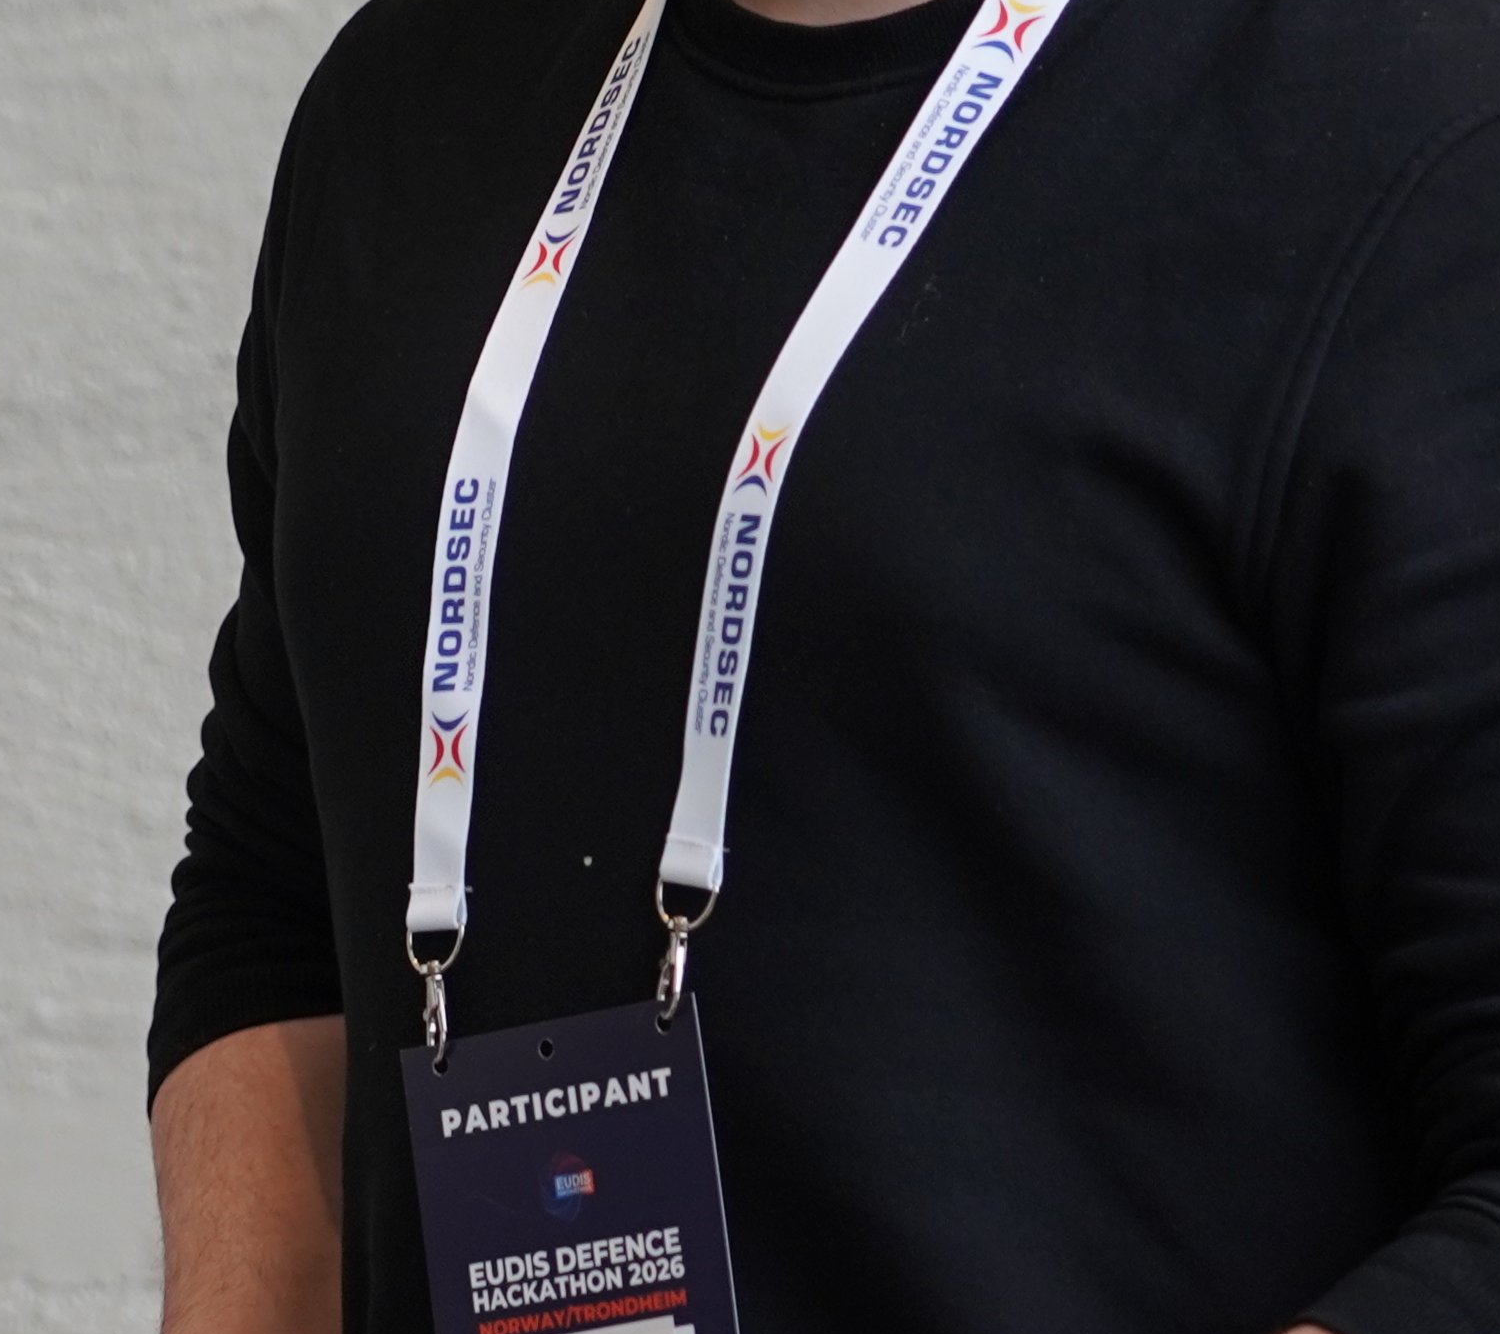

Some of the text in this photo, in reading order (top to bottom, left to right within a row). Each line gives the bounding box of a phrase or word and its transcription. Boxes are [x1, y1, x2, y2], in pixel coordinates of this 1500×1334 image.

[946, 64, 971, 97] Nordic
[553, 37, 641, 214] NORDSEC
[920, 98, 950, 139] Defence
[878, 72, 1002, 247] NORDSEC
[906, 141, 922, 160] and
[880, 162, 912, 203] Security
[719, 512, 735, 553] Nordic
[432, 478, 479, 692] NORDSEC
[462, 477, 496, 691] Nordic Defence and Security Cluster
[710, 556, 726, 606] Defence
[706, 609, 716, 632] and
[710, 514, 761, 736] NORDSEC
[699, 634, 715, 685] Security
[440, 1067, 671, 1138] PARTICIPANT
[468, 1226, 682, 1289] EUDIS DEFENCE
[472, 1255, 685, 1314] HACKATHON 2026
